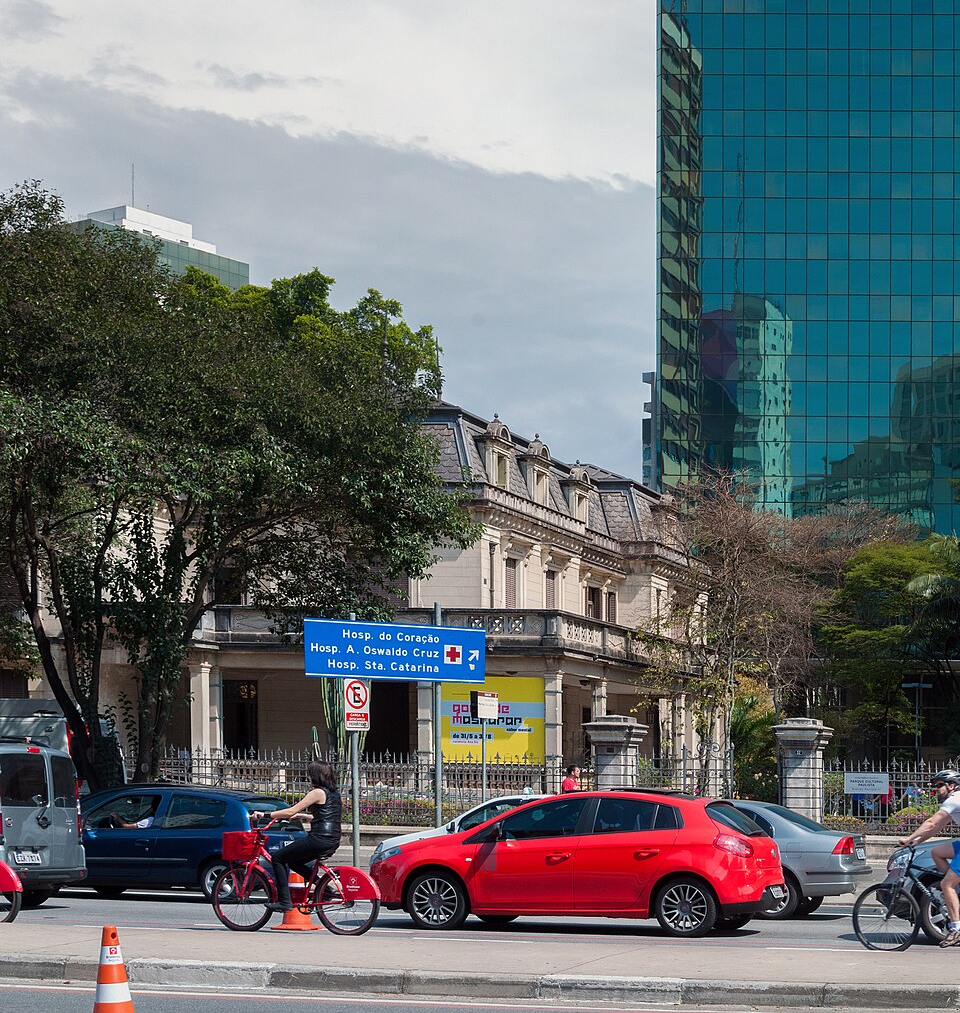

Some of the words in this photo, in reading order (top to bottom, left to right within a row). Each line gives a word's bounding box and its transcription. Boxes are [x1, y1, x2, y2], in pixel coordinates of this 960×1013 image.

[342, 629, 374, 641] Hosp.
[379, 631, 392, 641] do
[397, 632, 440, 645] Coração
[310, 642, 341, 655] Hosp.
[346, 644, 360, 655] A.
[363, 645, 408, 657] Oswaldo
[412, 648, 440, 659] Cruz
[327, 659, 359, 671] Hosp.
[364, 660, 386, 671] Sta.
[390, 662, 440, 673] Catarina
